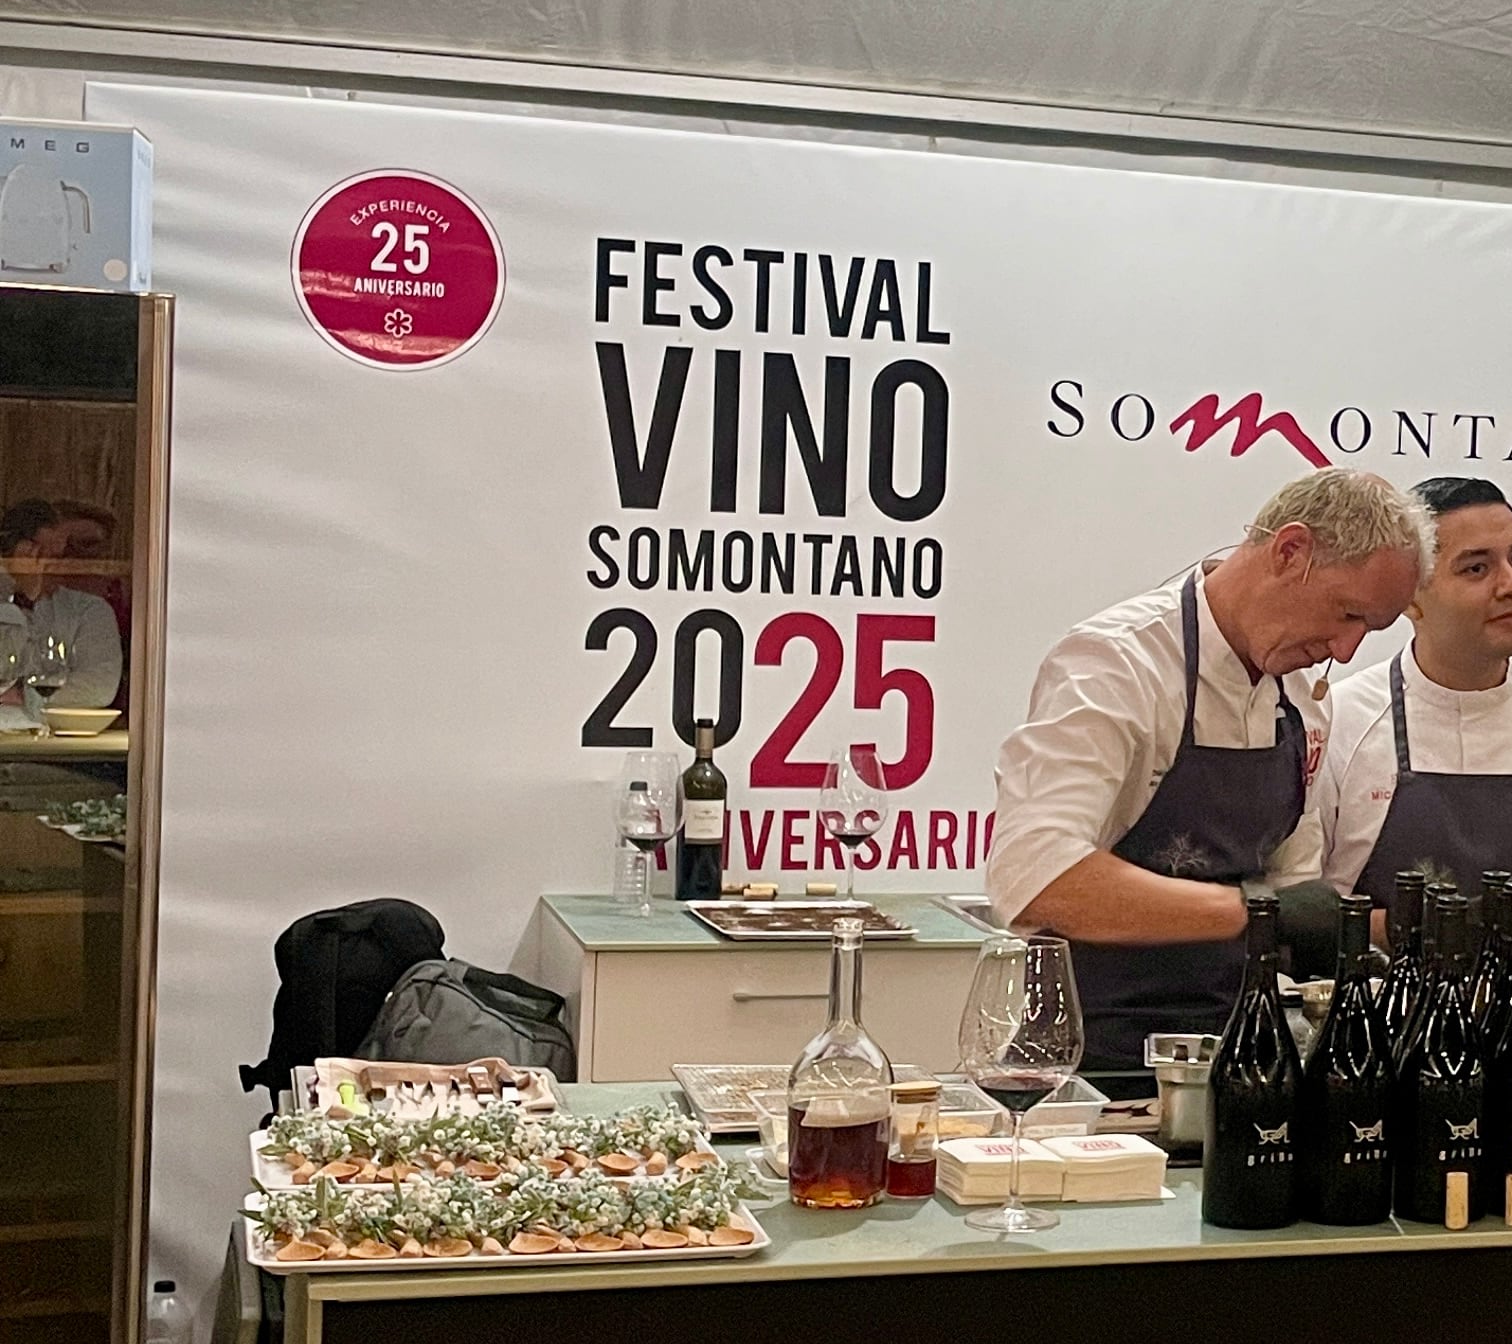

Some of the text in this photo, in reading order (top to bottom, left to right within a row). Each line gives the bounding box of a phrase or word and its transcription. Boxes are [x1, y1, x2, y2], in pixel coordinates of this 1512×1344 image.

[10, 137, 90, 154] MEG
[350, 199, 450, 233] EXPERIENCIA
[370, 221, 430, 275] 25
[353, 277, 445, 298] ANIVERSARIO
[595, 237, 951, 345] FESTIVAL
[595, 340, 951, 523] VINO
[586, 524, 944, 600] SOMONTANO
[581, 608, 937, 793] 2025
